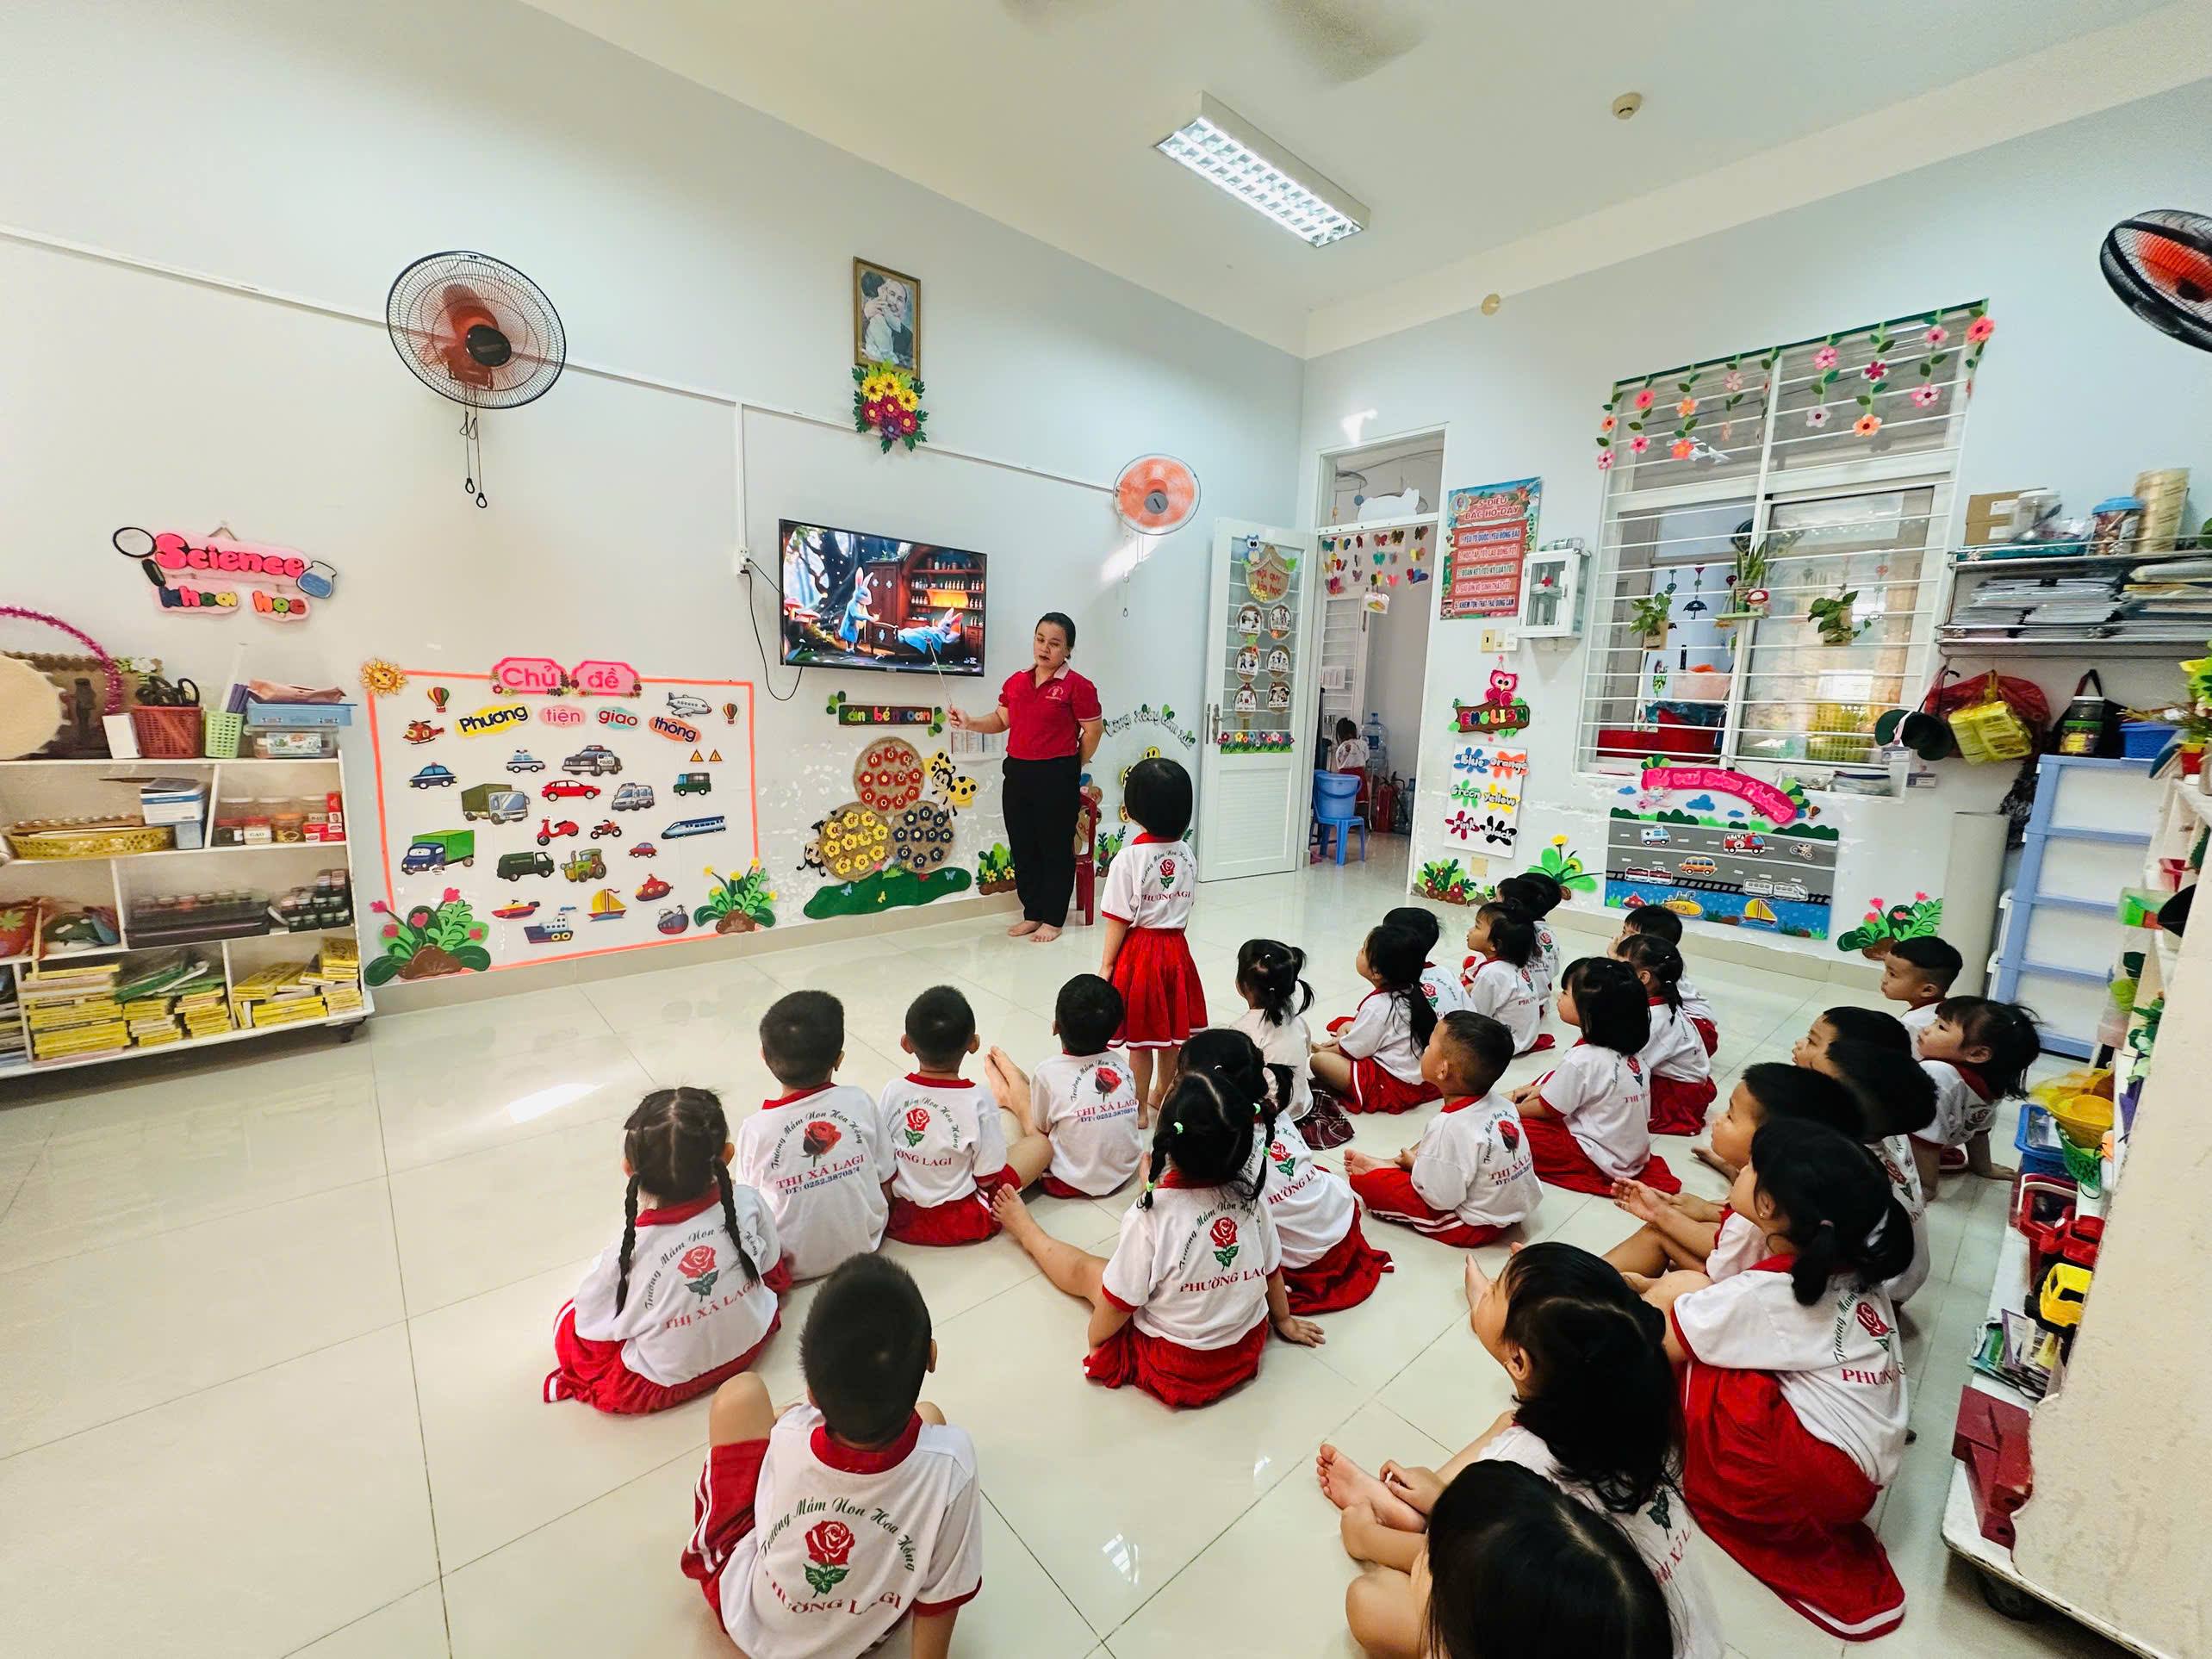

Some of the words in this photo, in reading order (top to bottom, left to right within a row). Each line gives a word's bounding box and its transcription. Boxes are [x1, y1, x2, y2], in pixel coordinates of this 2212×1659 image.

[155, 532, 305, 578] Science
[502, 665, 557, 687] Chủ
[587, 668, 620, 688] đề
[459, 705, 528, 732] Phương
[546, 709, 581, 725] tiện
[599, 709, 638, 726] giao
[654, 717, 697, 743] thông
[1460, 708, 1528, 726] ENGLISH
[1460, 754, 1484, 767] Blue
[1451, 785, 1482, 799] Green
[1483, 792, 1516, 806] Yellow
[1484, 824, 1513, 840] Black
[830, 1109, 848, 1123] Hoa
[896, 1147, 919, 1164] ỜNG
[923, 1157, 952, 1166] LAGI
[775, 1174, 804, 1190] THỊ
[808, 1163, 830, 1180] XÃ
[833, 1154, 865, 1172] LAGI
[1267, 1178, 1306, 1206] HƯỜNG
[688, 1228, 715, 1244] Non
[1179, 1271, 1239, 1293] PHƯỜNG
[696, 1300, 720, 1321] XÃ
[760, 1513, 791, 1560] Trường
[792, 1496, 827, 1519] Mầm
[831, 1496, 866, 1517] Non
[870, 1507, 899, 1536] Hoa
[897, 1533, 916, 1572] Hồng
